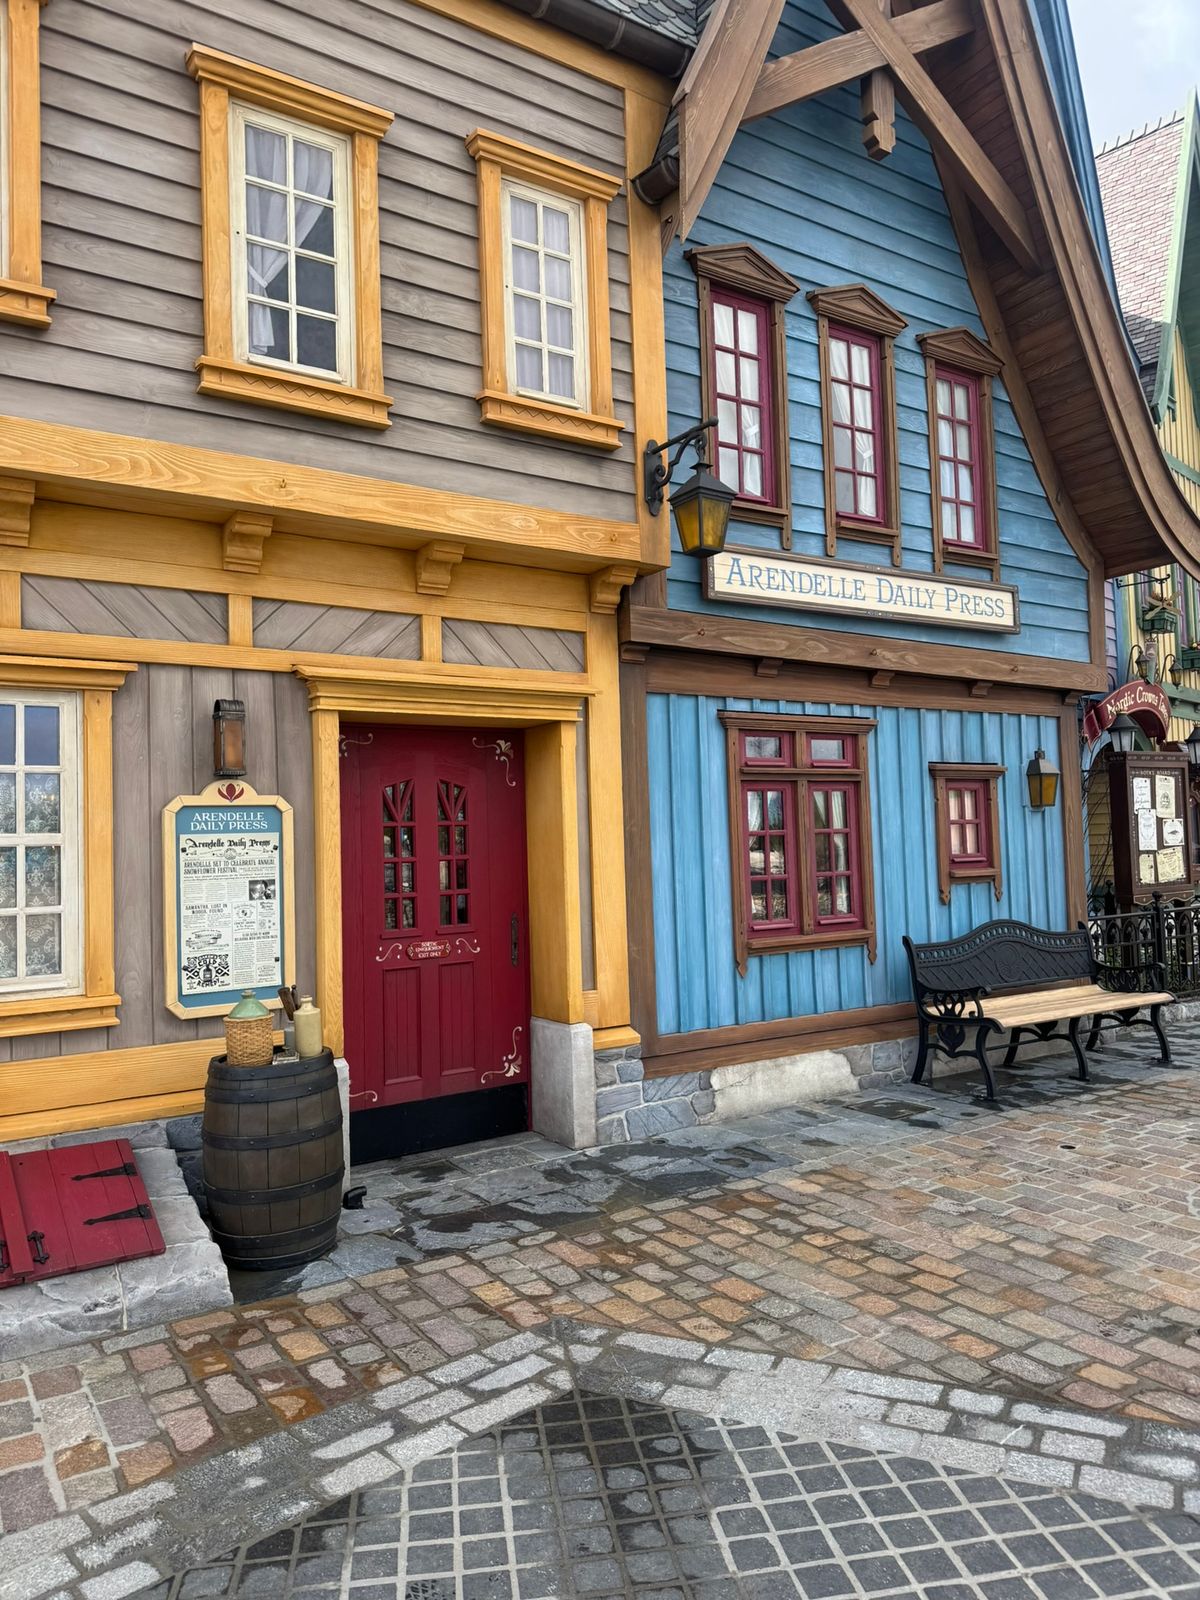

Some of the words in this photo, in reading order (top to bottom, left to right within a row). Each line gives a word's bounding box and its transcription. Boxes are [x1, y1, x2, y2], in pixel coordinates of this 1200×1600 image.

[726, 557, 866, 601] ARENDELLE
[876, 577, 936, 610] DAILY
[945, 587, 1005, 618] PRESS
[1106, 691, 1134, 719] Nordic
[1136, 686, 1158, 706] Crowns
[193, 812, 264, 822] ARENDELLE
[190, 822, 225, 830] DAILY
[229, 821, 268, 830] PRESS
[185, 838, 224, 849] Arendelle
[227, 838, 247, 850] Daily
[248, 838, 270, 847] Press
